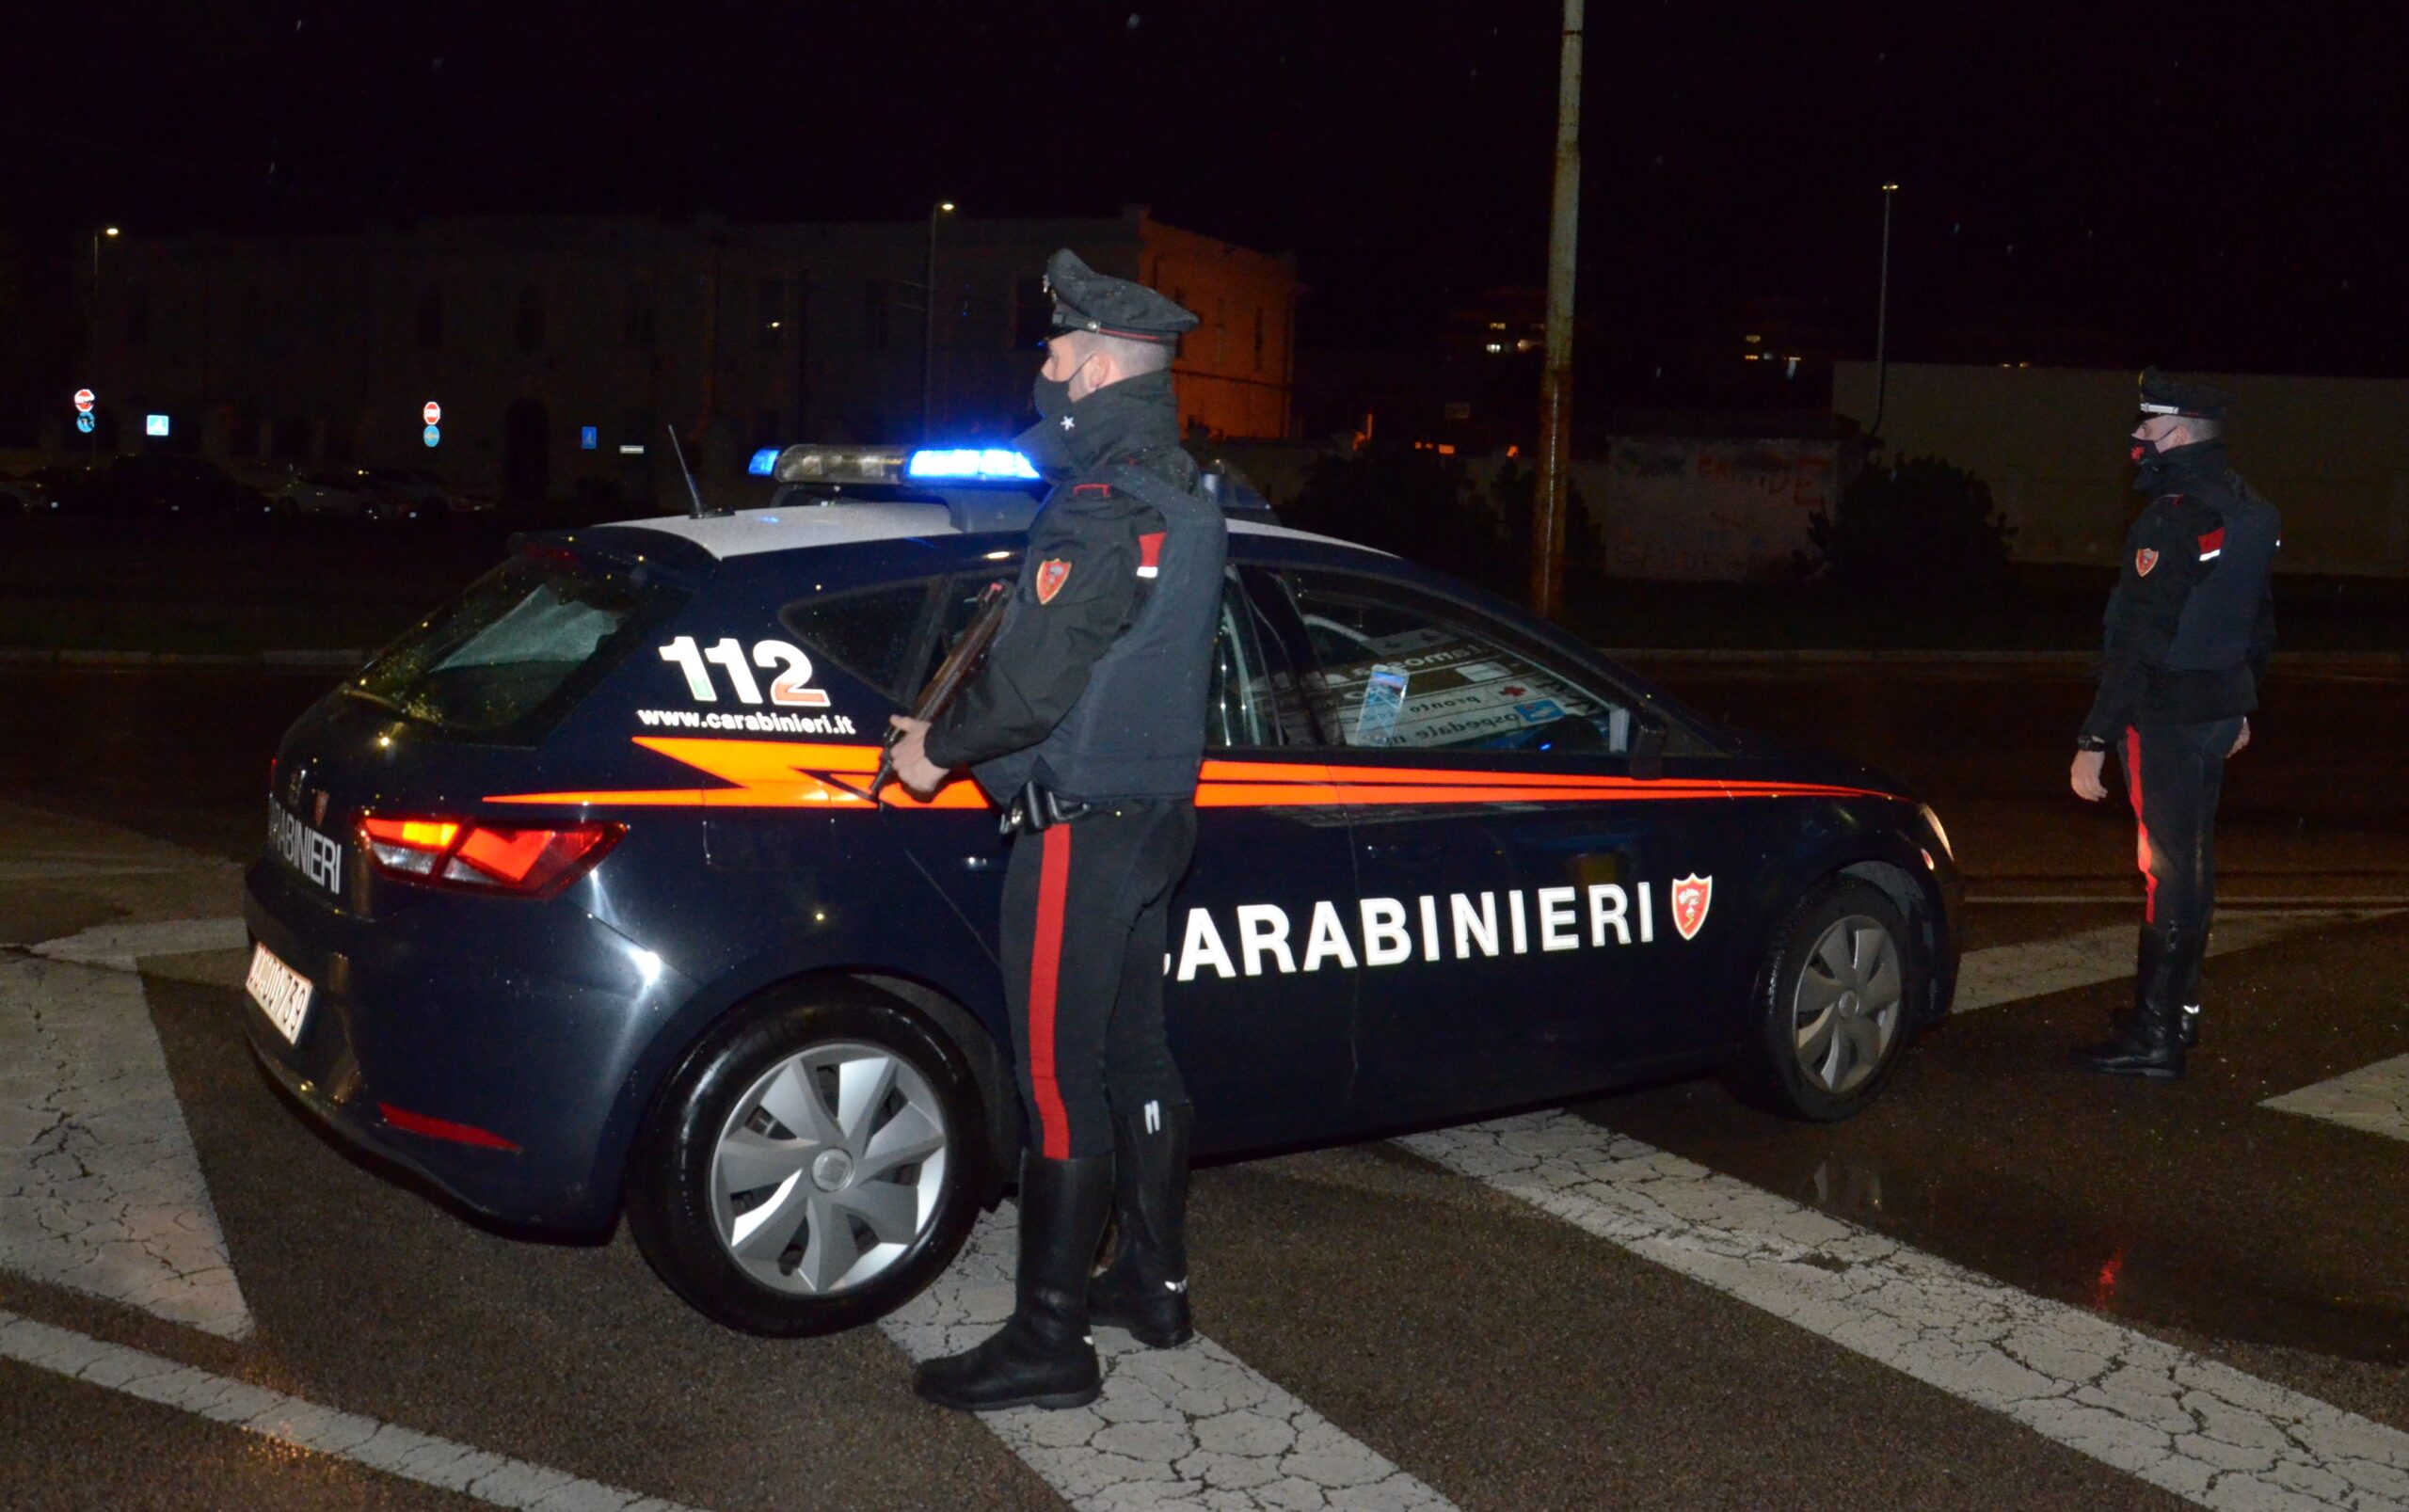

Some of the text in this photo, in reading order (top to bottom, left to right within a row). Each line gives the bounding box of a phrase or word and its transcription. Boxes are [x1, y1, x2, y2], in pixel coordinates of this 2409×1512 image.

[659, 636, 830, 707] 112
[637, 709, 855, 735] www.carabinieri.it
[1163, 882, 1654, 981] ARABINIERI
